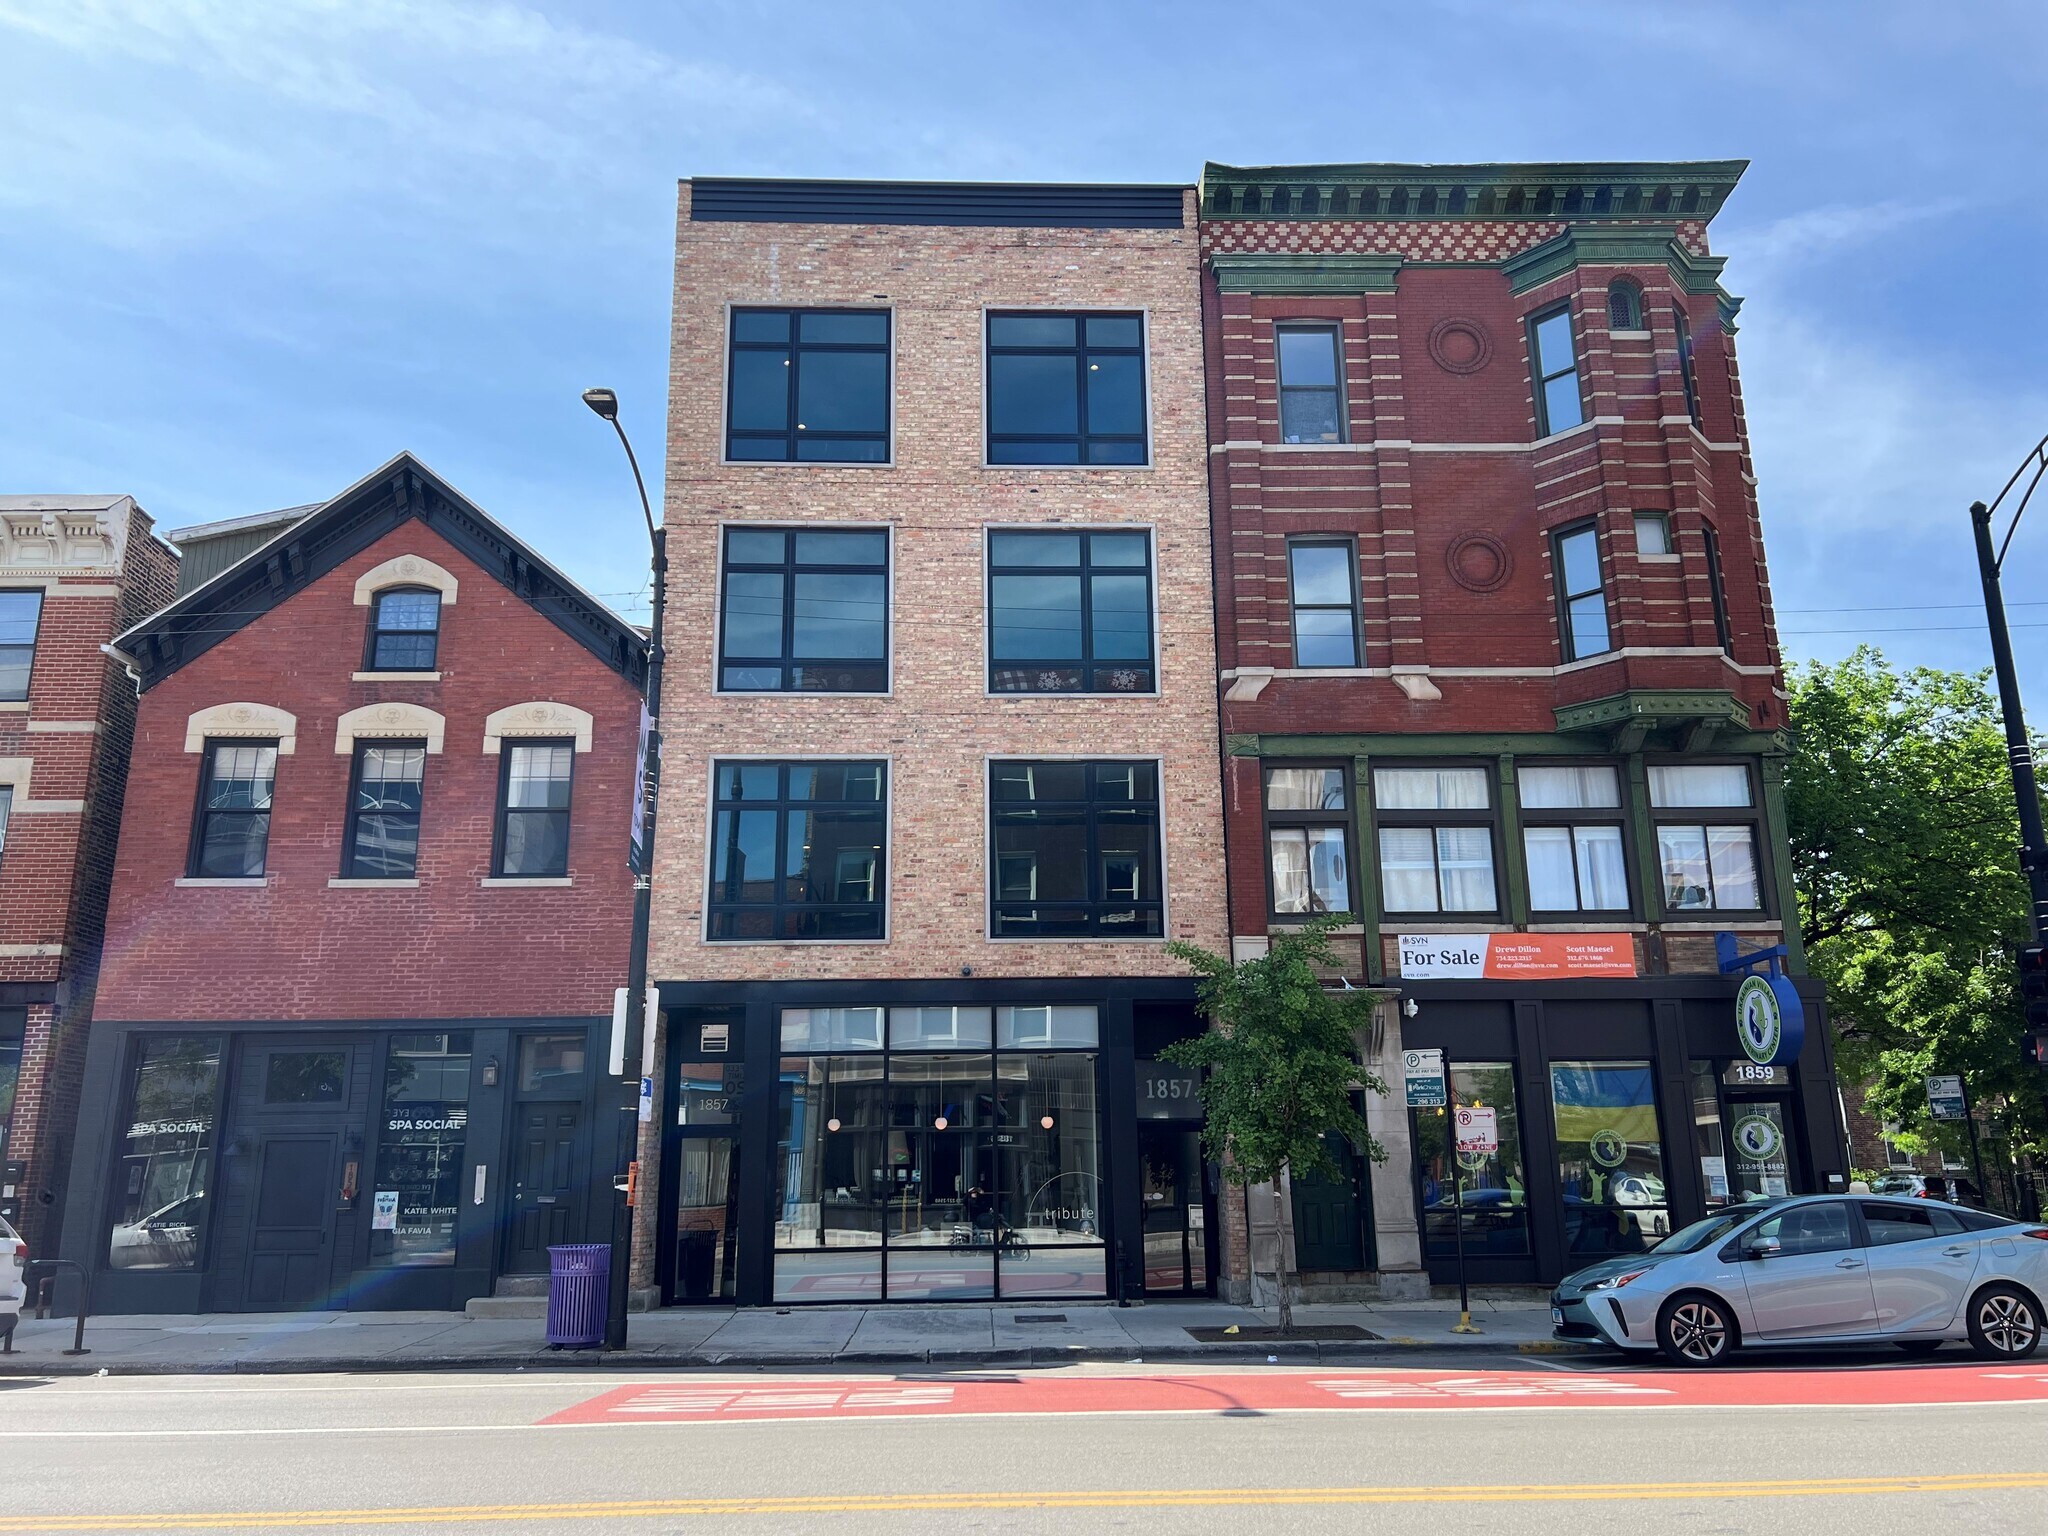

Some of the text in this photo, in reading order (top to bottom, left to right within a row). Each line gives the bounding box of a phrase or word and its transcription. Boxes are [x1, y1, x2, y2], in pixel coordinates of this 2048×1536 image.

[1410, 936, 1428, 945] SVN
[1518, 945, 1541, 953] Dillon
[1566, 945, 1614, 953] Scott Maesel
[1402, 949, 1480, 966] For Sale
[1736, 1066, 1774, 1079] 1859
[1146, 1079, 1193, 1099] 1857
[699, 1098, 728, 1110] 1857
[159, 1122, 206, 1133] SOCIAL
[388, 1120, 461, 1130] SPA SOCIAL
[404, 1206, 457, 1215] KATIE WHITE
[1045, 1207, 1094, 1220] tribute
[392, 1227, 432, 1235] GIA FAVIA
